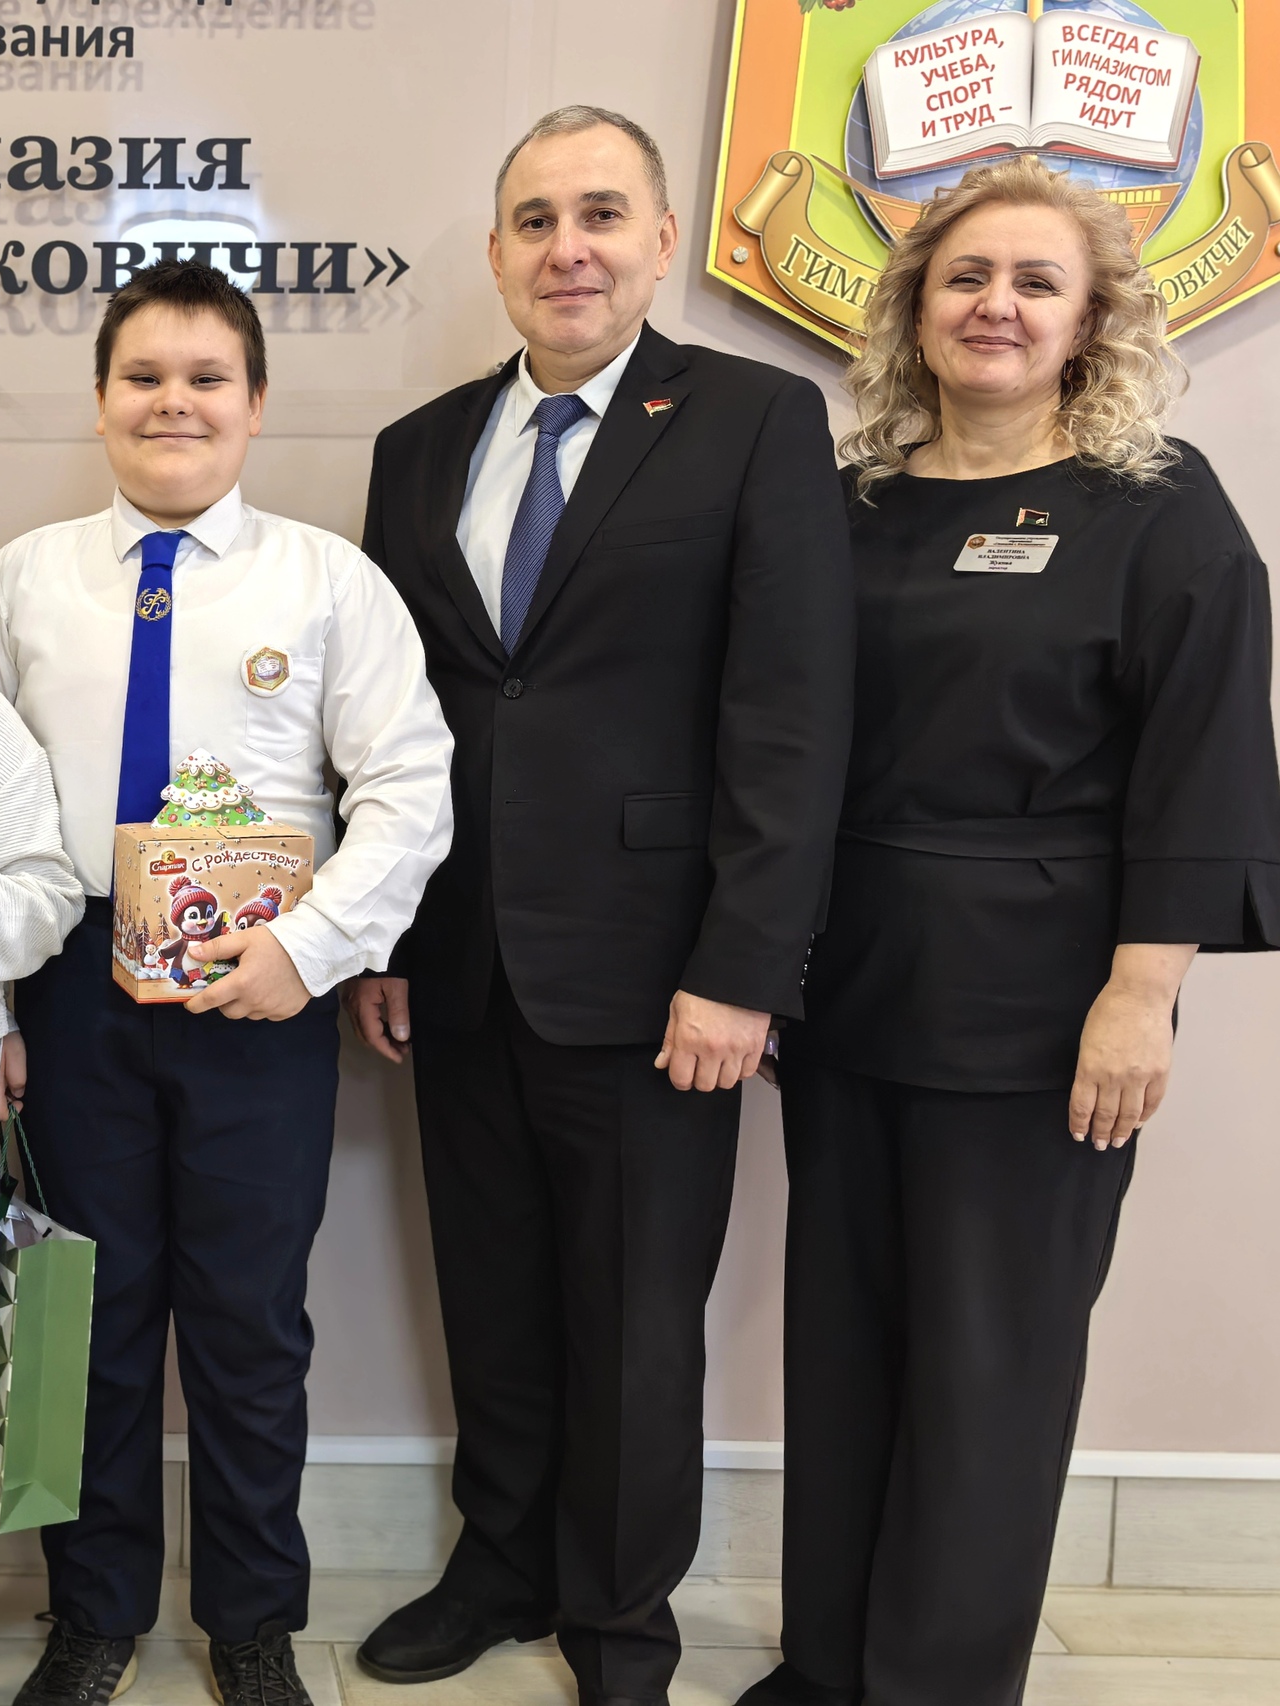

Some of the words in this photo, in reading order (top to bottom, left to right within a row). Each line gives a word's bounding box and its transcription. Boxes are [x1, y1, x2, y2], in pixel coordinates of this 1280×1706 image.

[894, 27, 1004, 68] КУЛЬТУРА,
[1062, 24, 1139, 54] ВСЕГДА
[1145, 39, 1159, 57] С
[921, 53, 996, 88] УЧЕБА,
[1052, 48, 1172, 87] ГИМНАЗИСТОМ
[926, 76, 994, 112] СПОРТ
[1063, 72, 1142, 106] РЯДОМ
[921, 120, 936, 138] И
[940, 103, 995, 134] ТРУД
[1079, 102, 1137, 129] ИДУТ
[1158, 218, 1252, 306] ОВИЧИ
[151, 862, 186, 873] Спартак
